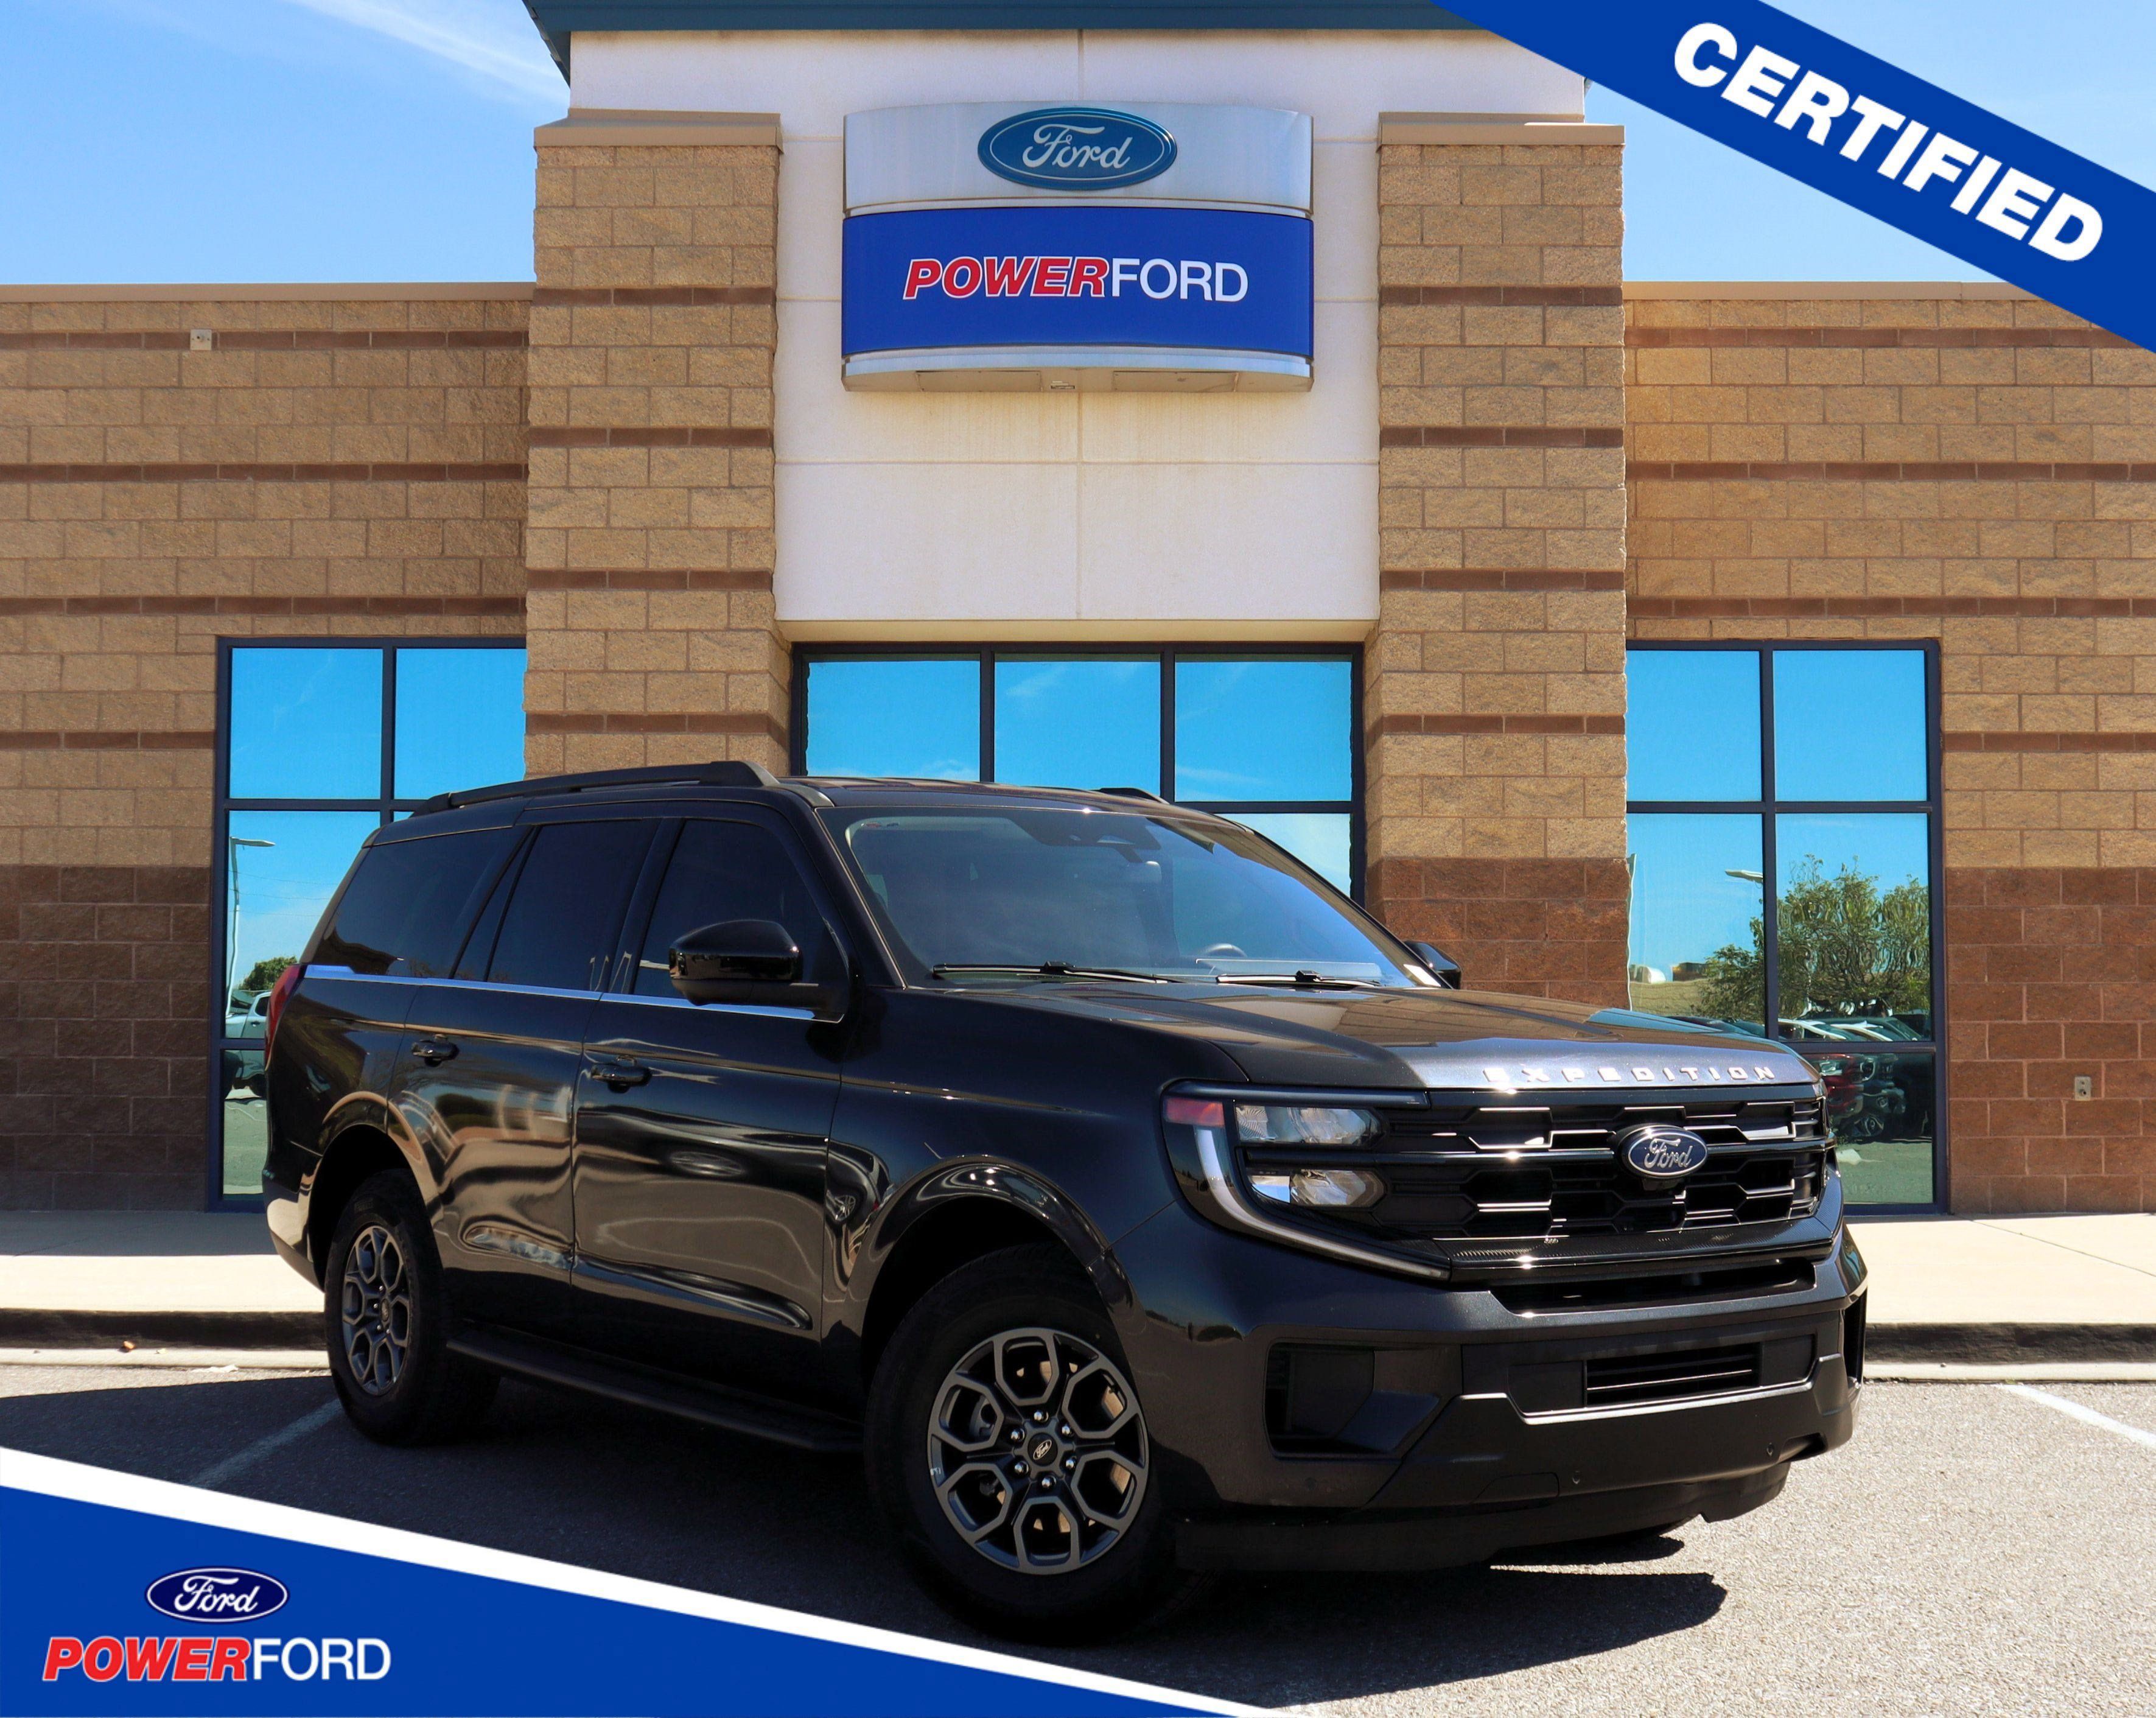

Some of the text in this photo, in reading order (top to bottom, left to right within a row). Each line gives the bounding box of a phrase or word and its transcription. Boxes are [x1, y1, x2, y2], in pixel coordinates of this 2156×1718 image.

[1023, 123, 1133, 169] Ford
[903, 256, 1248, 303] POWERFORD
[1483, 1067, 1776, 1082] EXPEDITION
[1644, 1138, 1693, 1168] Ford
